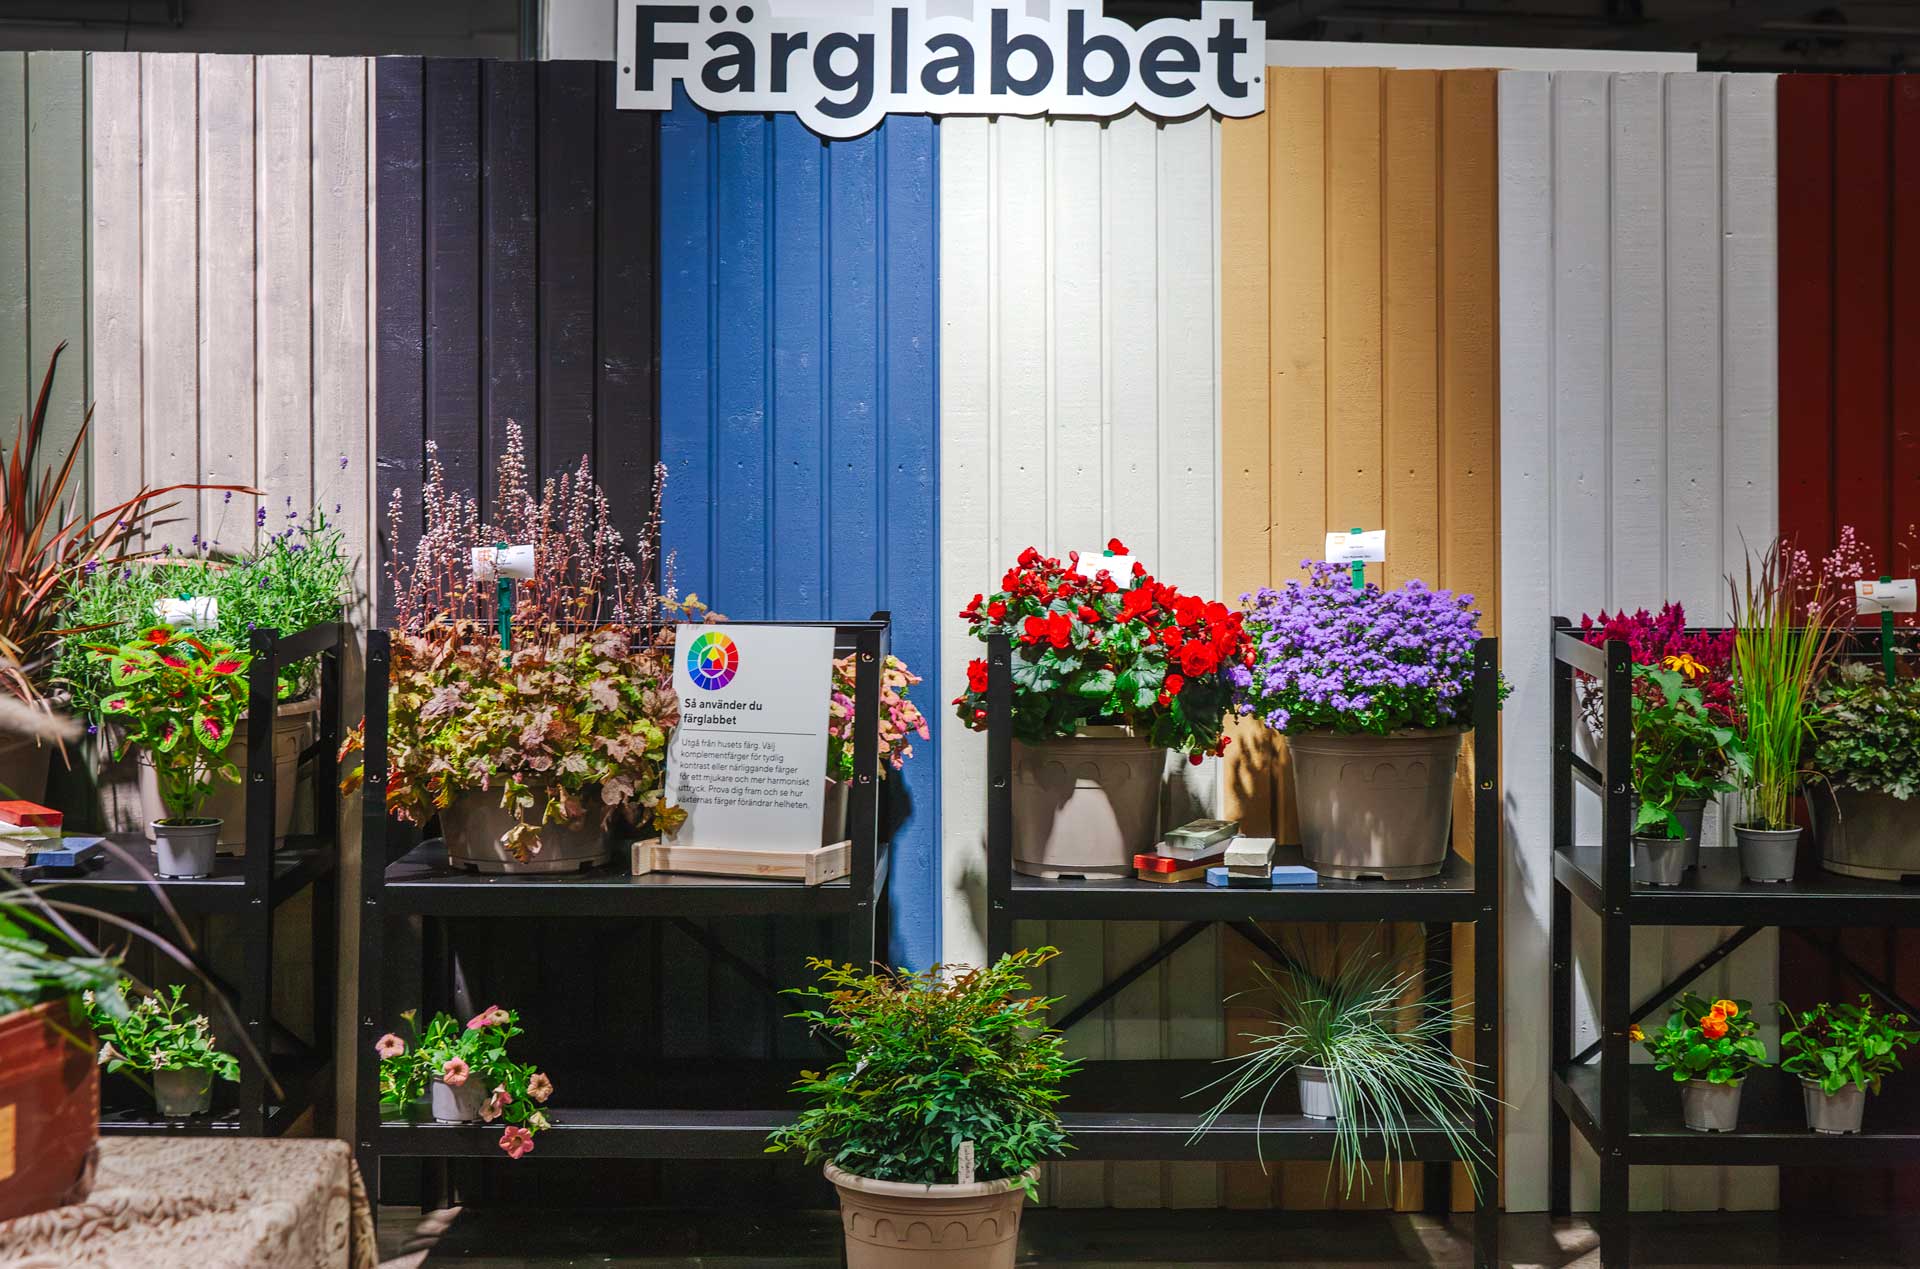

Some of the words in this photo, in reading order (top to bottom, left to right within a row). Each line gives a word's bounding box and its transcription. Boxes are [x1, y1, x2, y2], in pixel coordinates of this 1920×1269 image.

[634, 4, 1248, 119] Färglabbet
[684, 698, 697, 709] Så
[699, 699, 747, 711] använder
[749, 700, 763, 711] du
[683, 713, 737, 726] färglabbet
[681, 739, 700, 748] Utgå
[701, 739, 716, 748] från
[717, 740, 742, 749] husets
[743, 741, 761, 751] färg.
[762, 742, 776, 752] Välj
[680, 751, 749, 761] komplementfärger
[750, 752, 761, 761] för
[762, 753, 784, 763] tydlig
[679, 761, 711, 770] kontrast
[711, 763, 728, 771] eller
[728, 764, 774, 774] närliggande
[775, 765, 798, 775] färger
[679, 772, 690, 780] för
[703, 774, 734, 783] mjukare
[735, 775, 749, 783] och
[750, 776, 767, 784] mer
[767, 777, 810, 786] harmoniskt
[708, 785, 730, 794] Prova
[731, 786, 744, 796] dig
[744, 787, 762, 795] fram
[763, 788, 778, 796] och
[779, 789, 789, 797] se
[790, 789, 803, 797] hur
[677, 796, 712, 804] växternas
[713, 796, 737, 807] färger
[737, 798, 774, 808] förändrar
